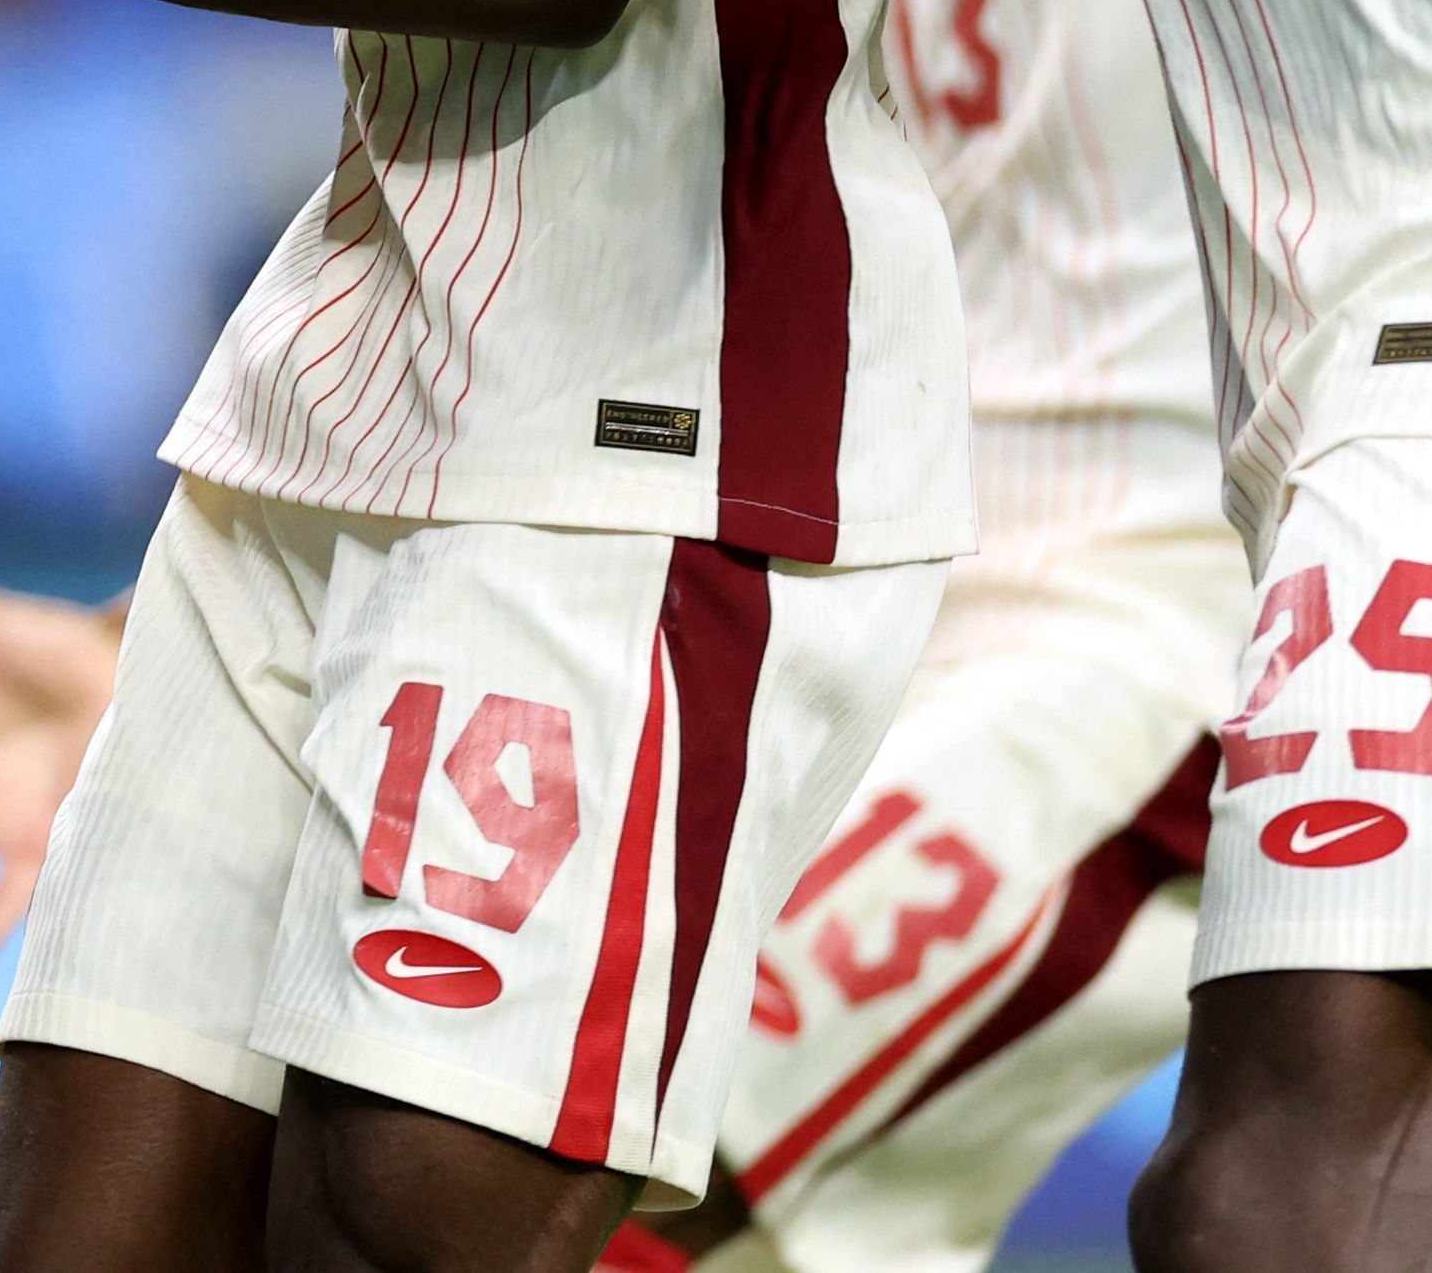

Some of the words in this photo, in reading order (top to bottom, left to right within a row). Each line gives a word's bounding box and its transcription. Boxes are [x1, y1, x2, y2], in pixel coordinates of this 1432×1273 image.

[1219, 558, 1432, 793] 25
[360, 681, 581, 933] 19
[774, 791, 999, 1005] 13
